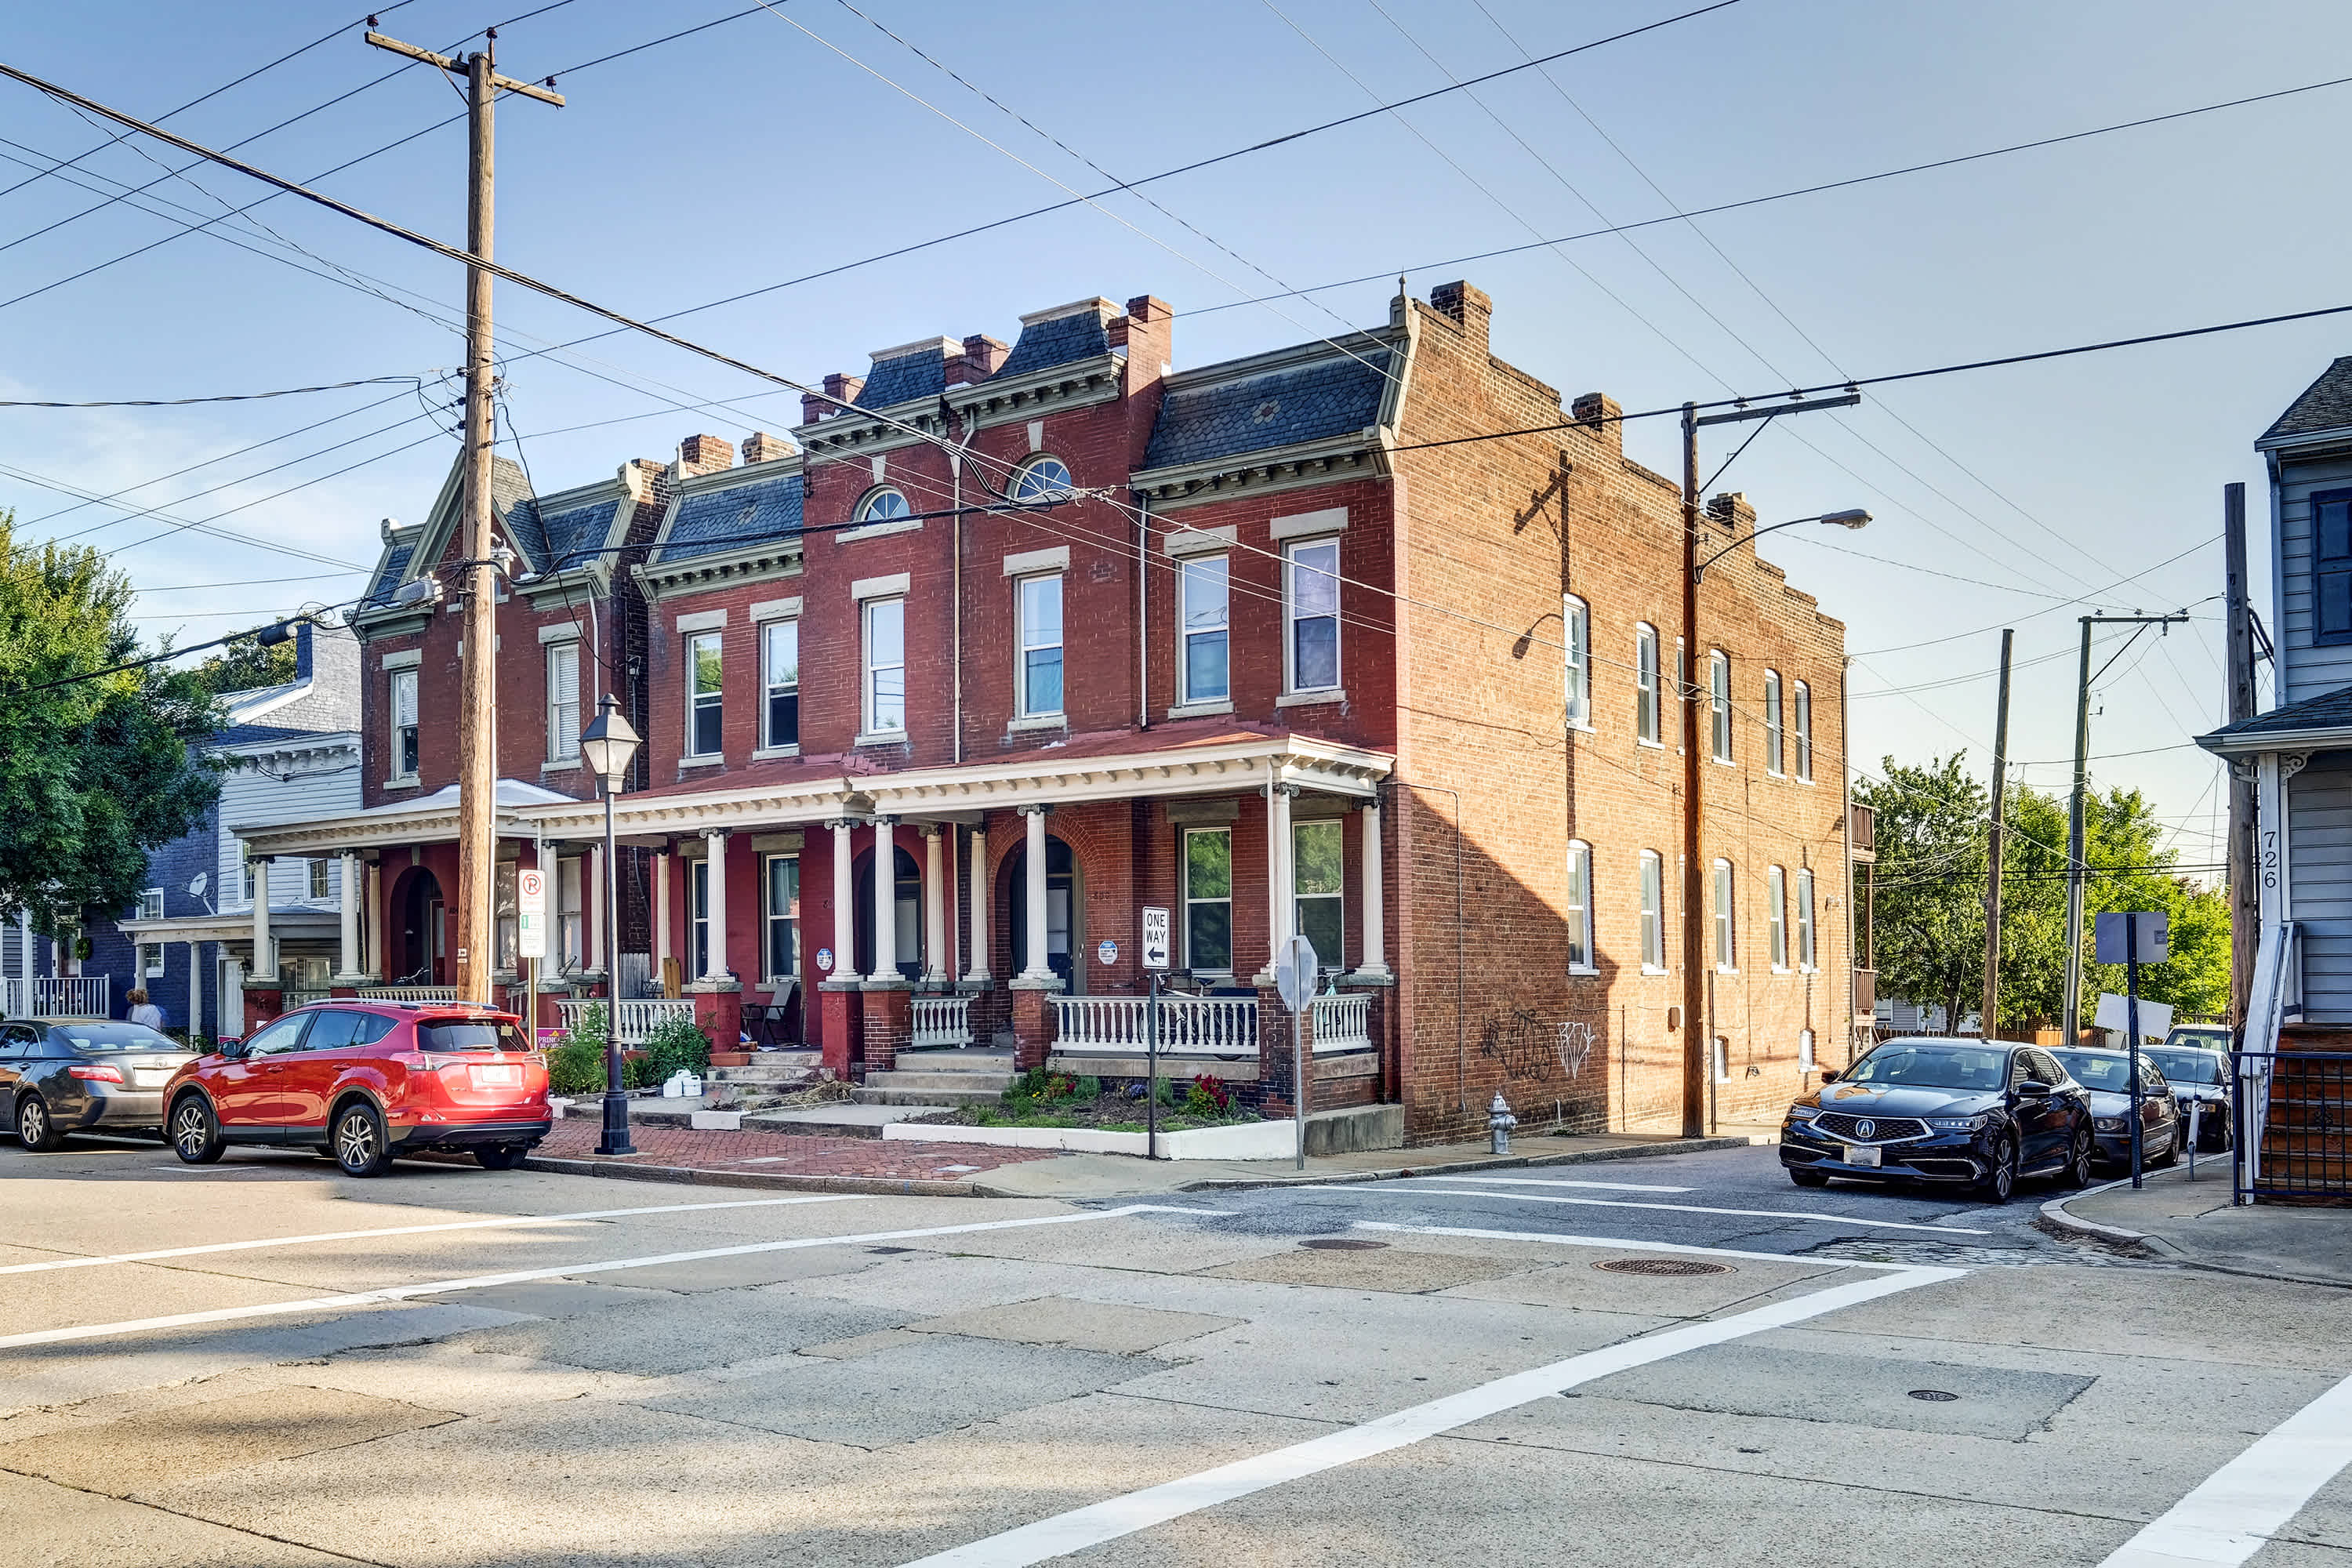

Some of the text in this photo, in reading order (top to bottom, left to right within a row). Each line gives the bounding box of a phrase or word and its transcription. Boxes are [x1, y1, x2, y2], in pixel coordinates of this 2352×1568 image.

[2264, 831, 2278, 888] 726
[1147, 913, 1166, 927] ONE
[1146, 929, 1166, 945] WAY
